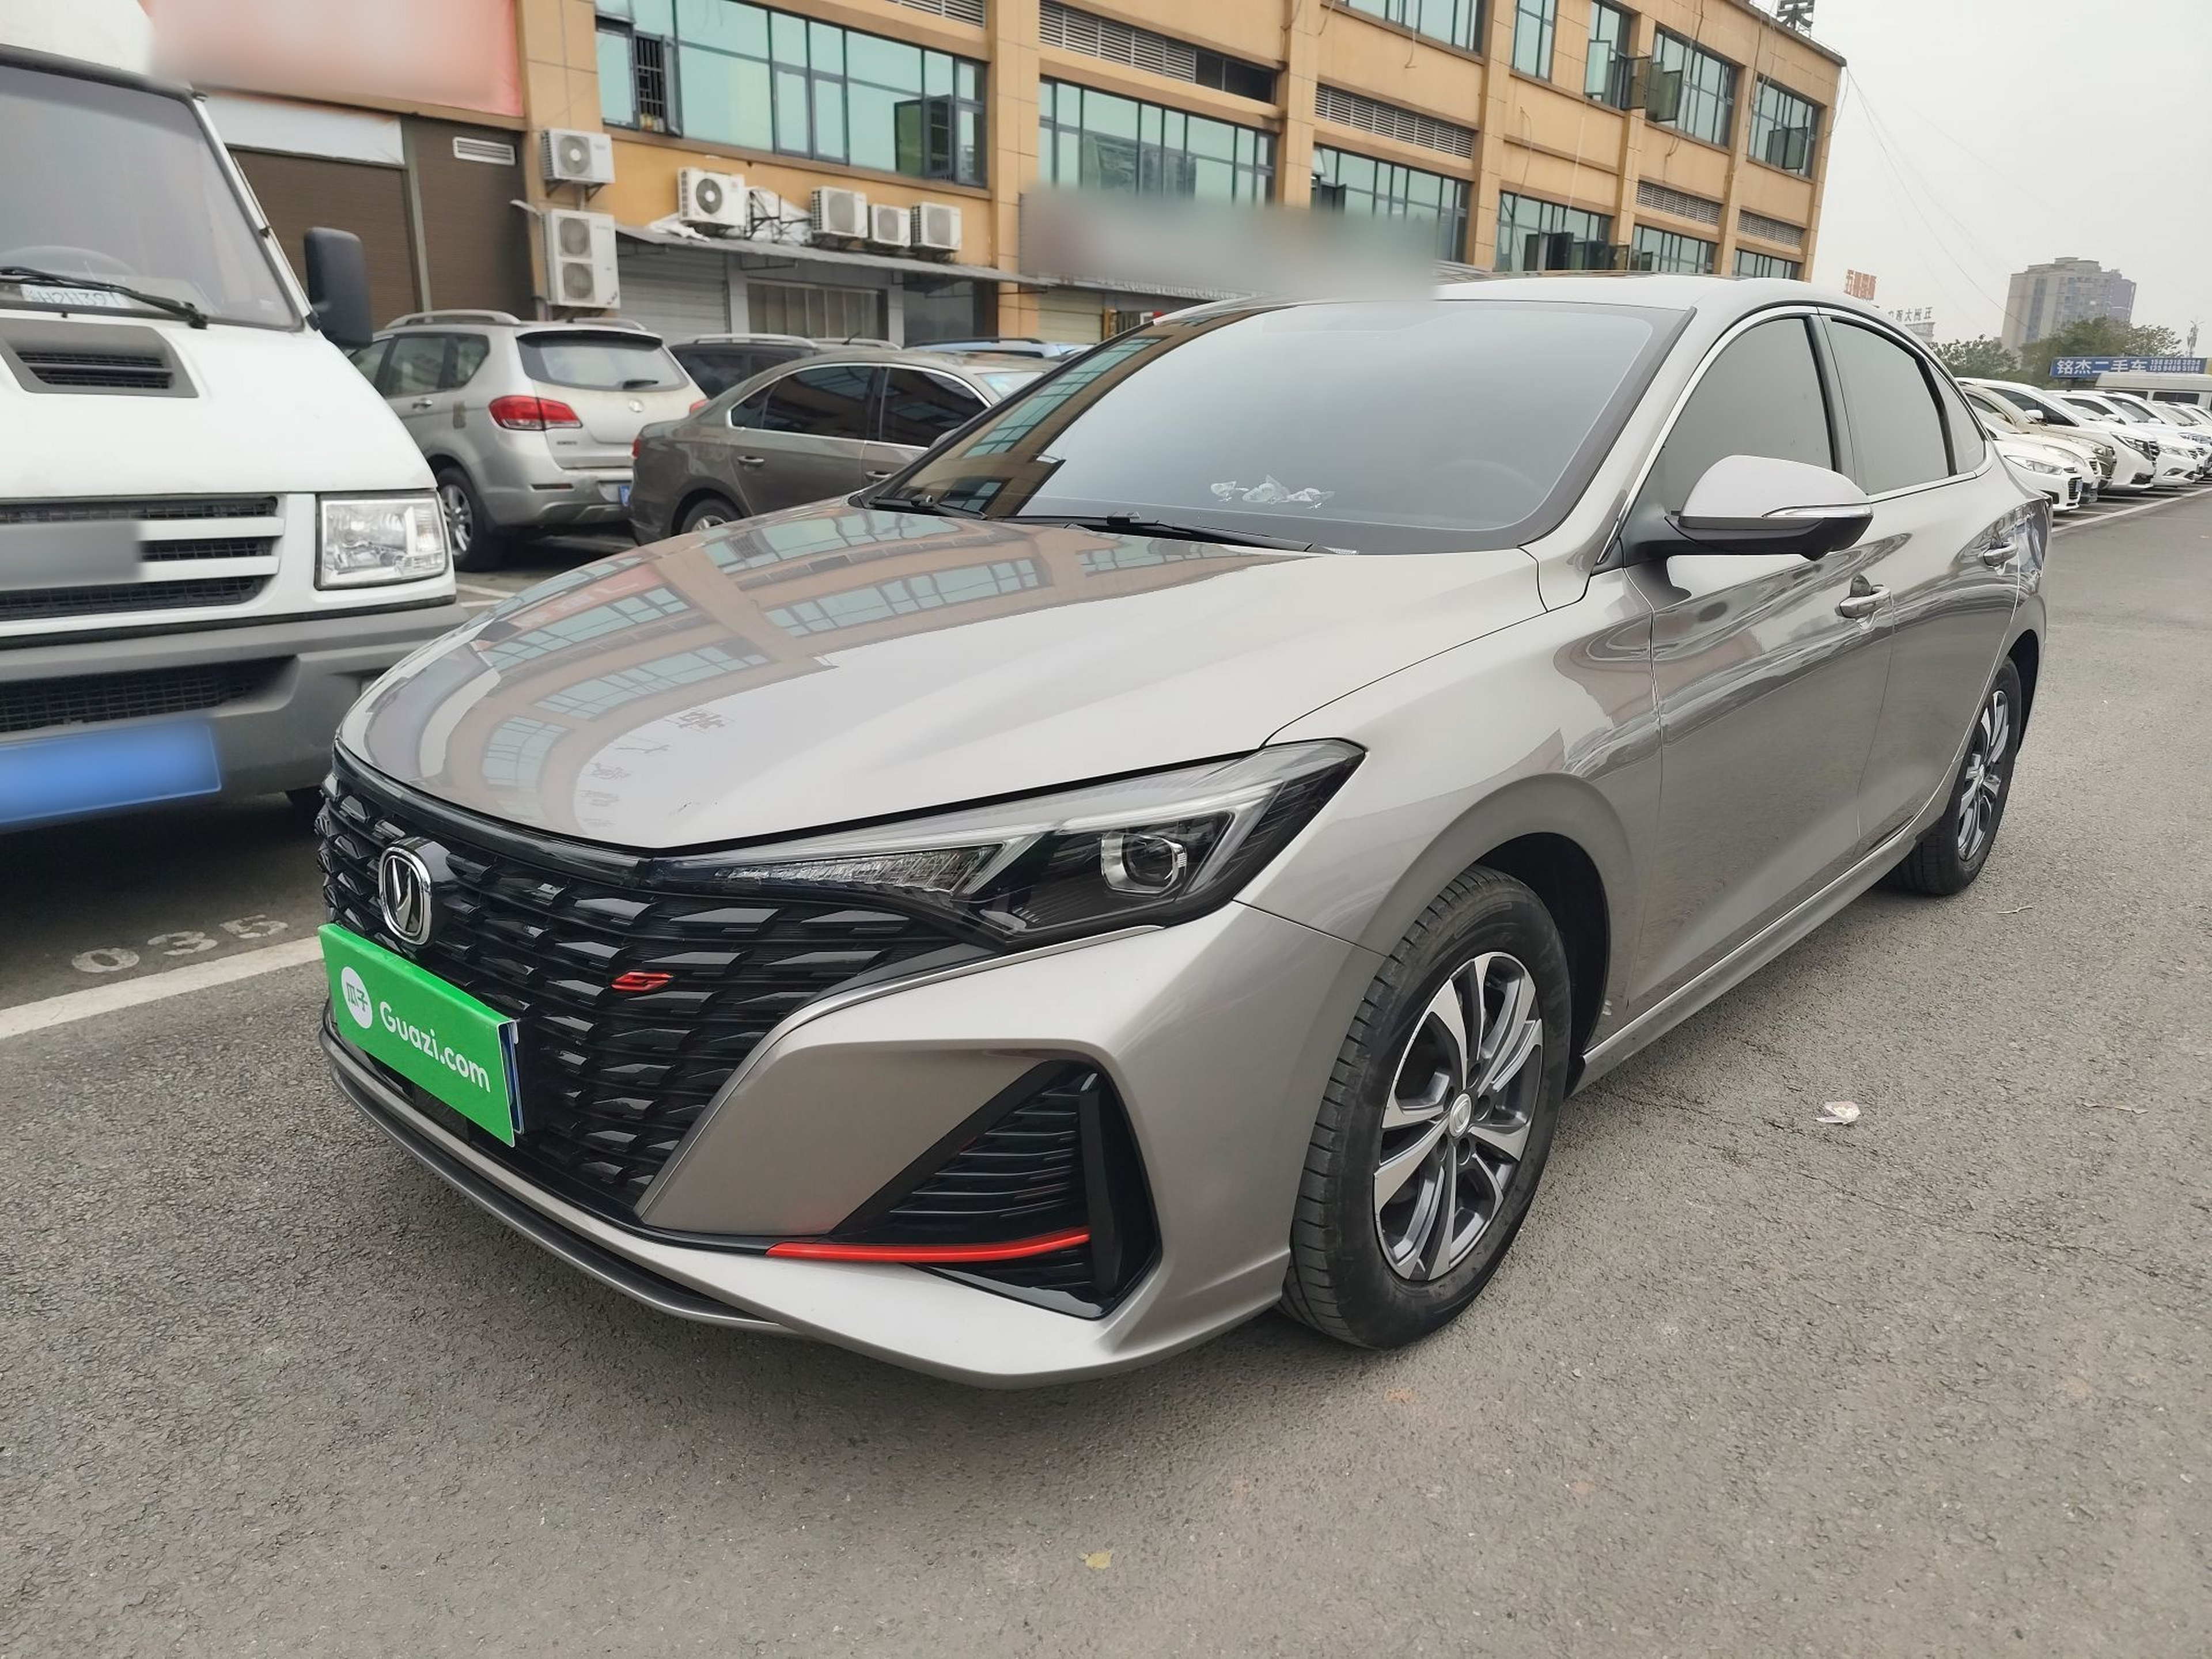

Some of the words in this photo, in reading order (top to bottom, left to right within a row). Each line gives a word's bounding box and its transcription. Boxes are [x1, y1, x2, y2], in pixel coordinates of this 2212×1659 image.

[2056, 359, 2147, 374] 铭杰二手车
[71, 914, 289, 974] 035
[346, 982, 368, 1013] 瓜子
[379, 1001, 491, 1093] Guazi.com
